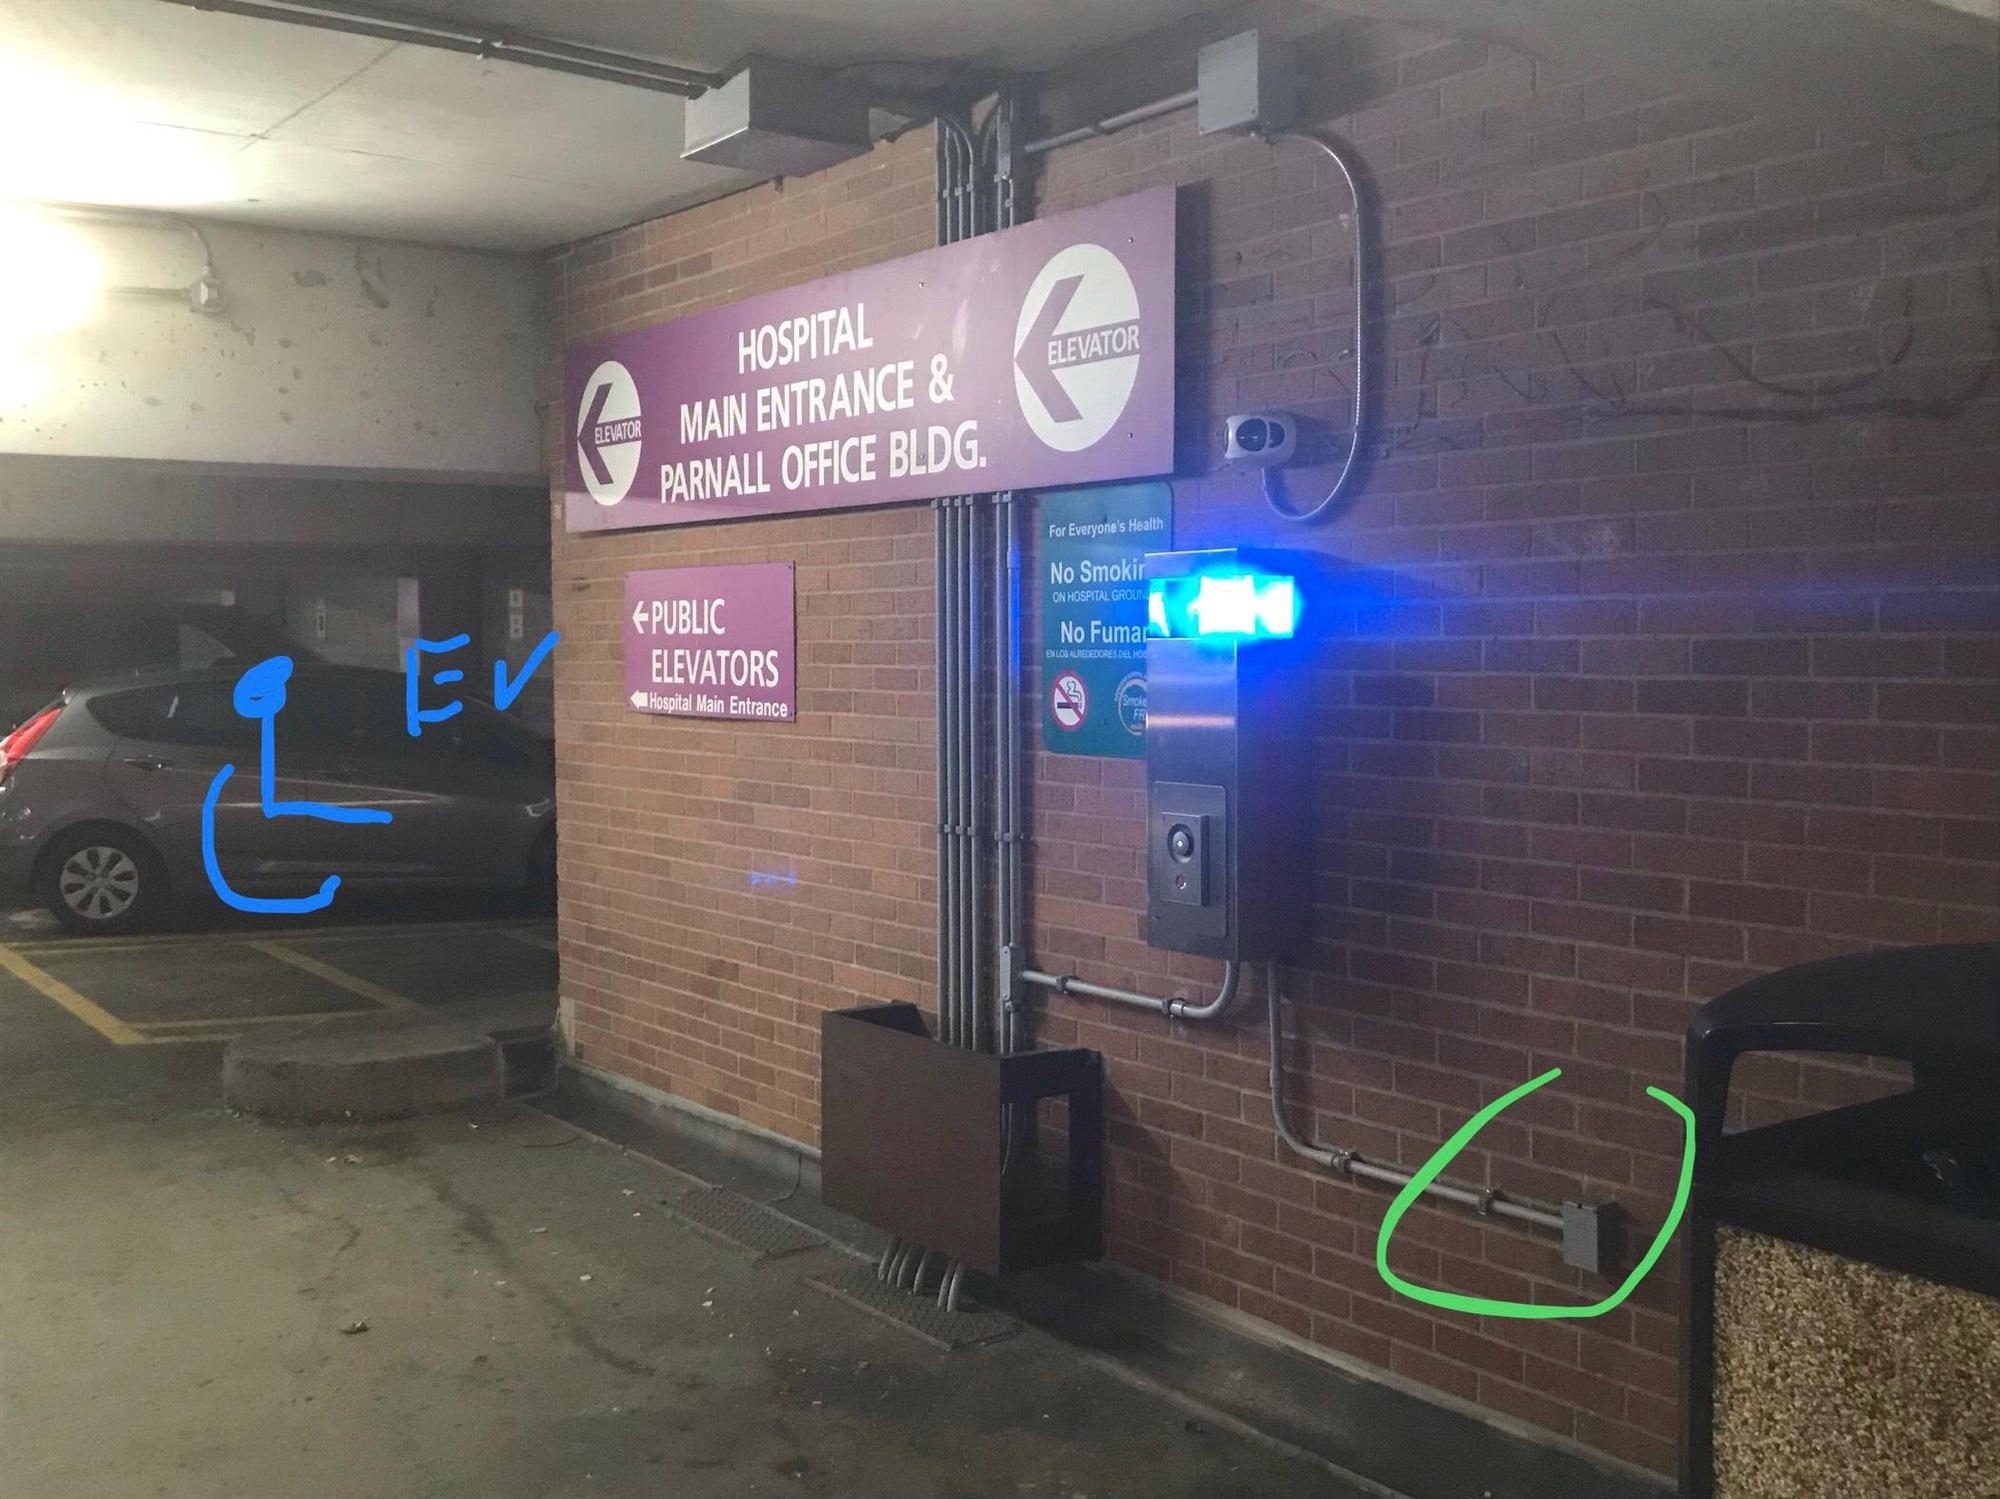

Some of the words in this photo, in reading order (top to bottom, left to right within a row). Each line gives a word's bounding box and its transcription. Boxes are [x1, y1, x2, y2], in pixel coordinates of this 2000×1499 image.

[738, 302, 874, 374] HOSPITAL
[1048, 325, 1140, 365] ELEVATOR
[680, 392, 747, 445] MAIN
[757, 360, 915, 432] ENTRANCE
[928, 353, 955, 404] &
[595, 420, 642, 444] ELEVATOR
[660, 450, 771, 503] PARNALL
[781, 433, 877, 490] OFFICE
[889, 419, 987, 478] BLDG.
[1049, 524, 1066, 538] For
[1069, 519, 1126, 538] Everyone's
[1129, 516, 1164, 532] Health
[1051, 562, 1074, 584] No
[1080, 558, 1146, 583] Smokin
[1052, 592, 1066, 603] ON
[1067, 590, 1110, 602] HOSPITAL
[652, 598, 726, 635] PUBLIC
[1061, 621, 1085, 643] No
[1090, 620, 1149, 643] Fumar
[652, 649, 780, 688] ELEVATORS
[650, 692, 692, 713] Hospital
[696, 693, 725, 713] Main
[730, 695, 788, 717] Entrance
[1133, 708, 1146, 721] FR
